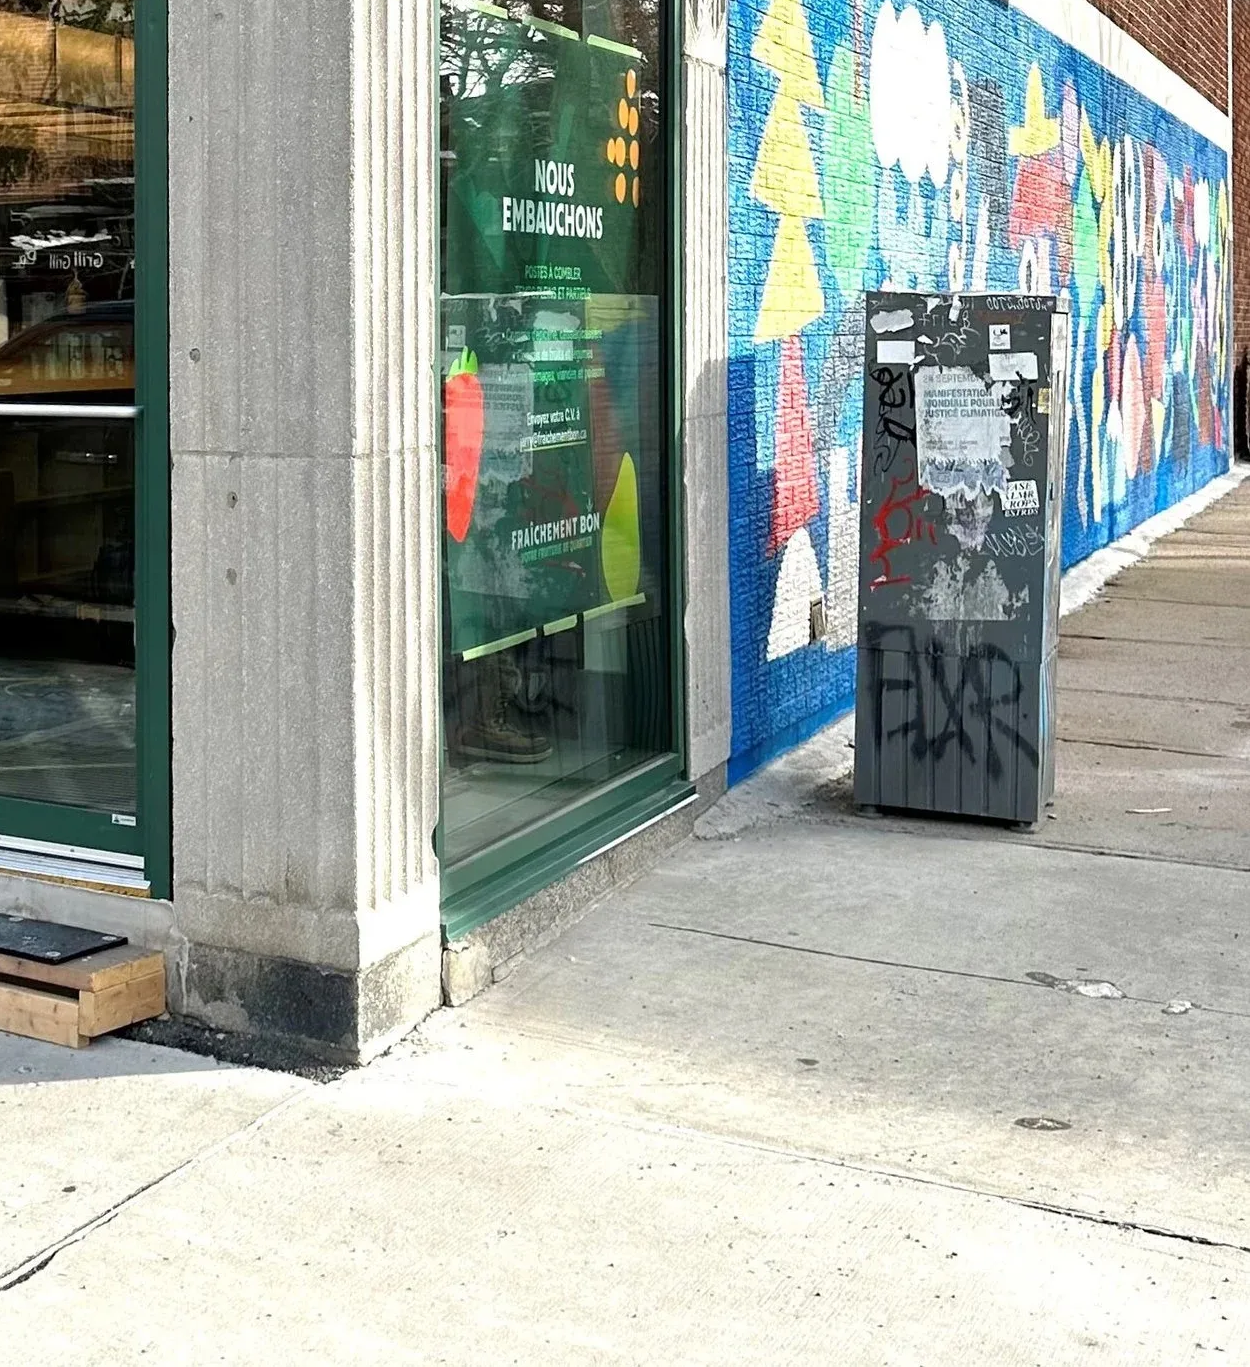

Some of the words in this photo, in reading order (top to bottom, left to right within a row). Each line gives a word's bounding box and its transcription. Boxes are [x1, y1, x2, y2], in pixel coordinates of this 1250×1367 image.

[534, 159, 575, 197] NOUS
[502, 197, 603, 239] EMBAUCHONS
[935, 373, 980, 384] SEPTEMB
[923, 388, 992, 398] MANIFESTATION
[923, 398, 968, 408] MONDIALE
[970, 398, 994, 408] POUR
[924, 408, 958, 419] JUSTICE
[512, 517, 578, 551] FRAÎCHEMENT
[580, 512, 600, 534] BON
